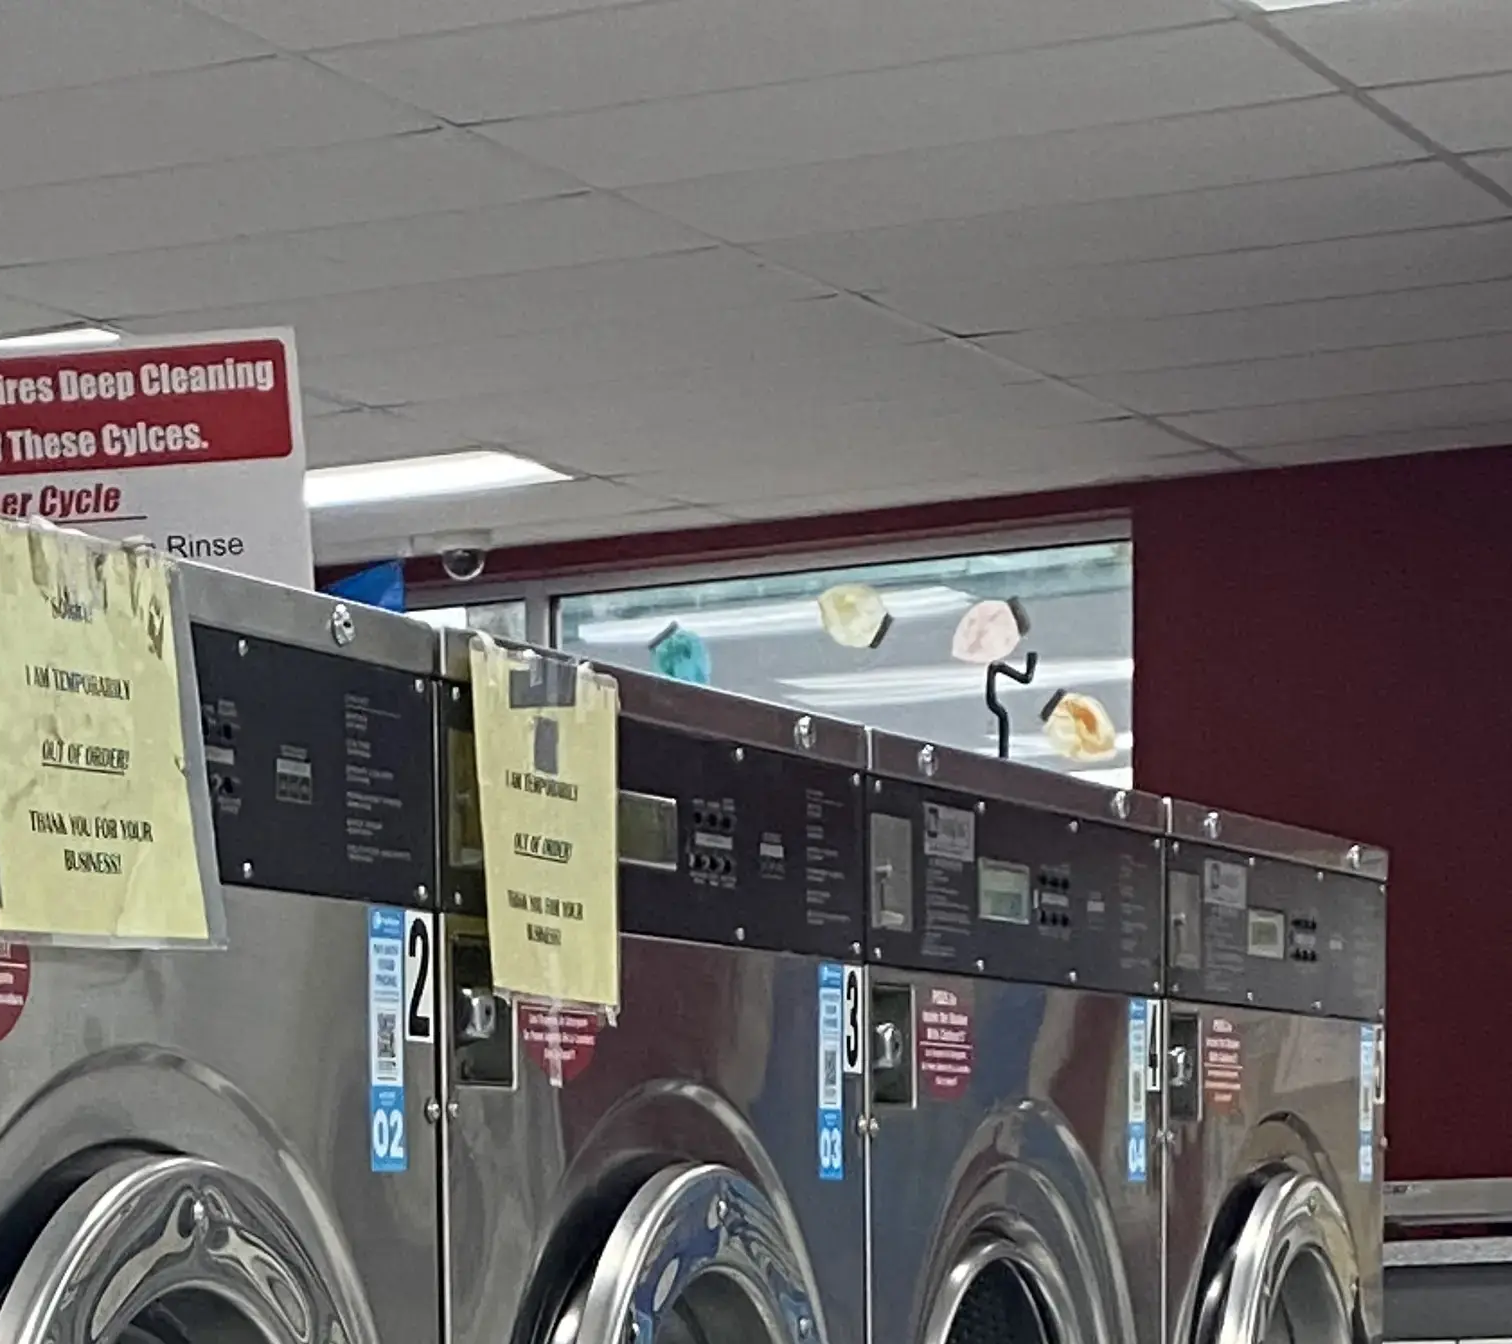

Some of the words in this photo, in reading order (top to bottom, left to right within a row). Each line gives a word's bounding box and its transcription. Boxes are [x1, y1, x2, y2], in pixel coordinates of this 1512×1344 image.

[58, 369, 135, 401] Deep
[140, 357, 275, 396] Cleaning
[6, 427, 96, 461] These
[101, 421, 210, 457] Cylces.
[39, 483, 122, 518] Cycle
[167, 534, 245, 558] Rinse
[25, 664, 31, 686] I
[69, 814, 91, 837] YOU
[119, 819, 154, 843] YOUR
[408, 917, 431, 1037] 2
[846, 970, 859, 1068] 3
[373, 1108, 404, 1158] 02
[819, 1127, 842, 1169] 03
